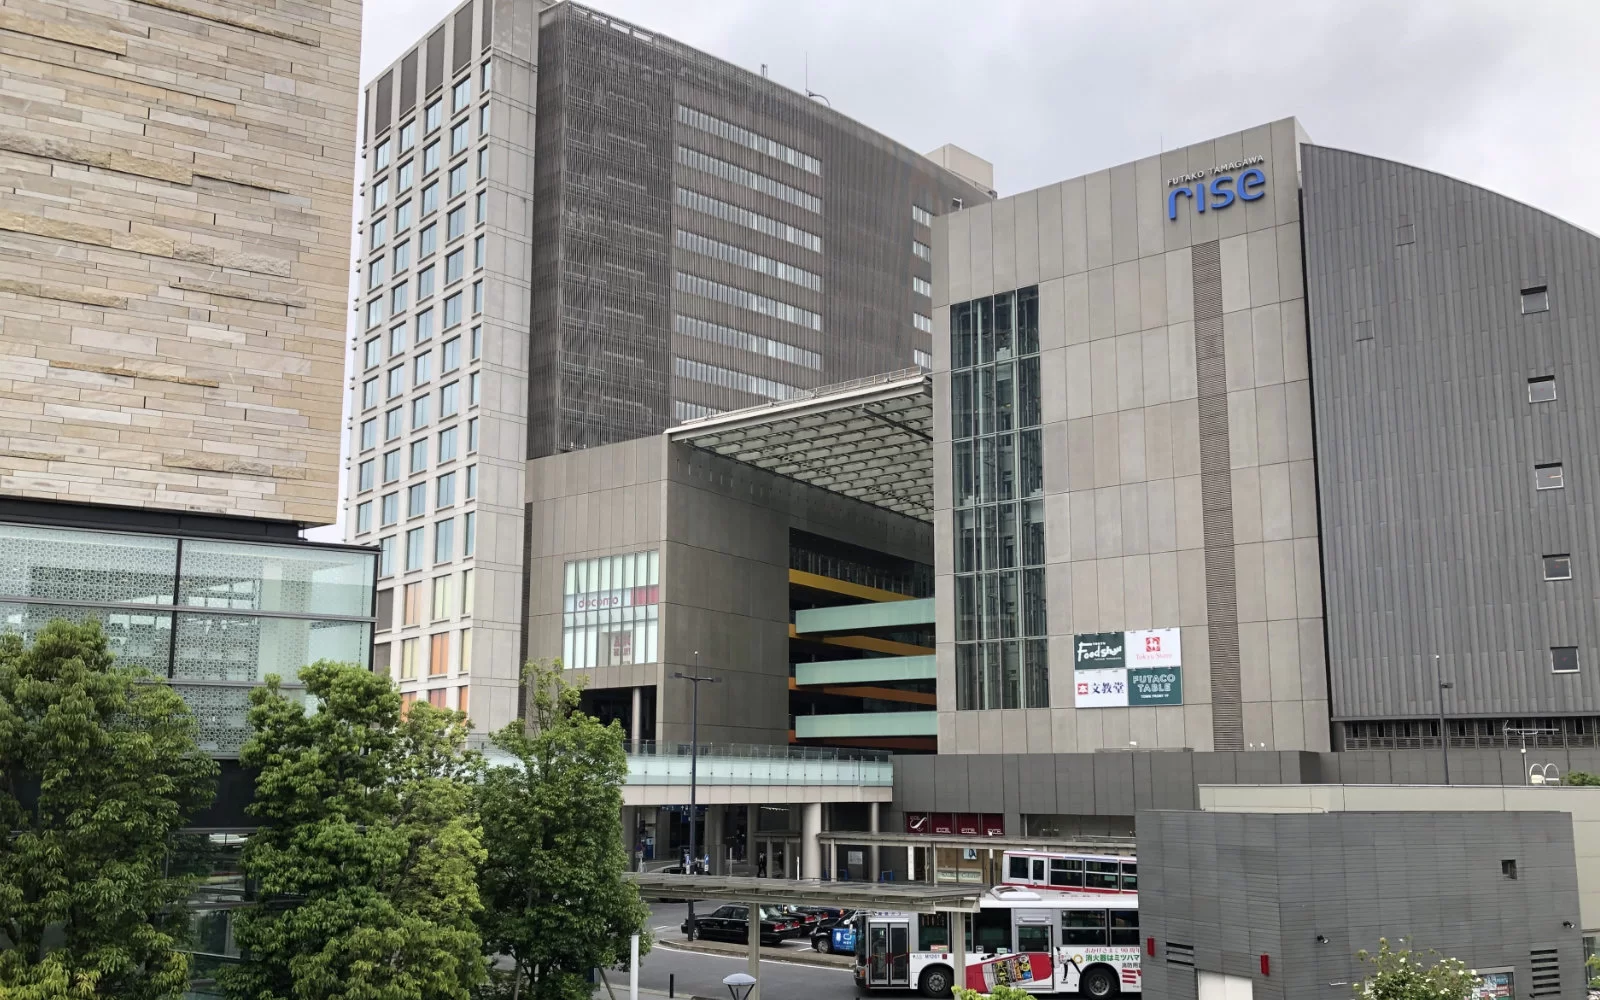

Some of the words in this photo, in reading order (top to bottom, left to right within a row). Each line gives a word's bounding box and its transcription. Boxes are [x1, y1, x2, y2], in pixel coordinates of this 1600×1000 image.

[1167, 170, 1204, 186] FUTAKO
[1208, 155, 1264, 176] TAMAGAWA
[1168, 168, 1266, 220] rise
[578, 596, 619, 608] docomo
[1132, 673, 1176, 684] FUTACO
[1092, 681, 1125, 694] 文教堂
[1137, 682, 1171, 693] TABLE
